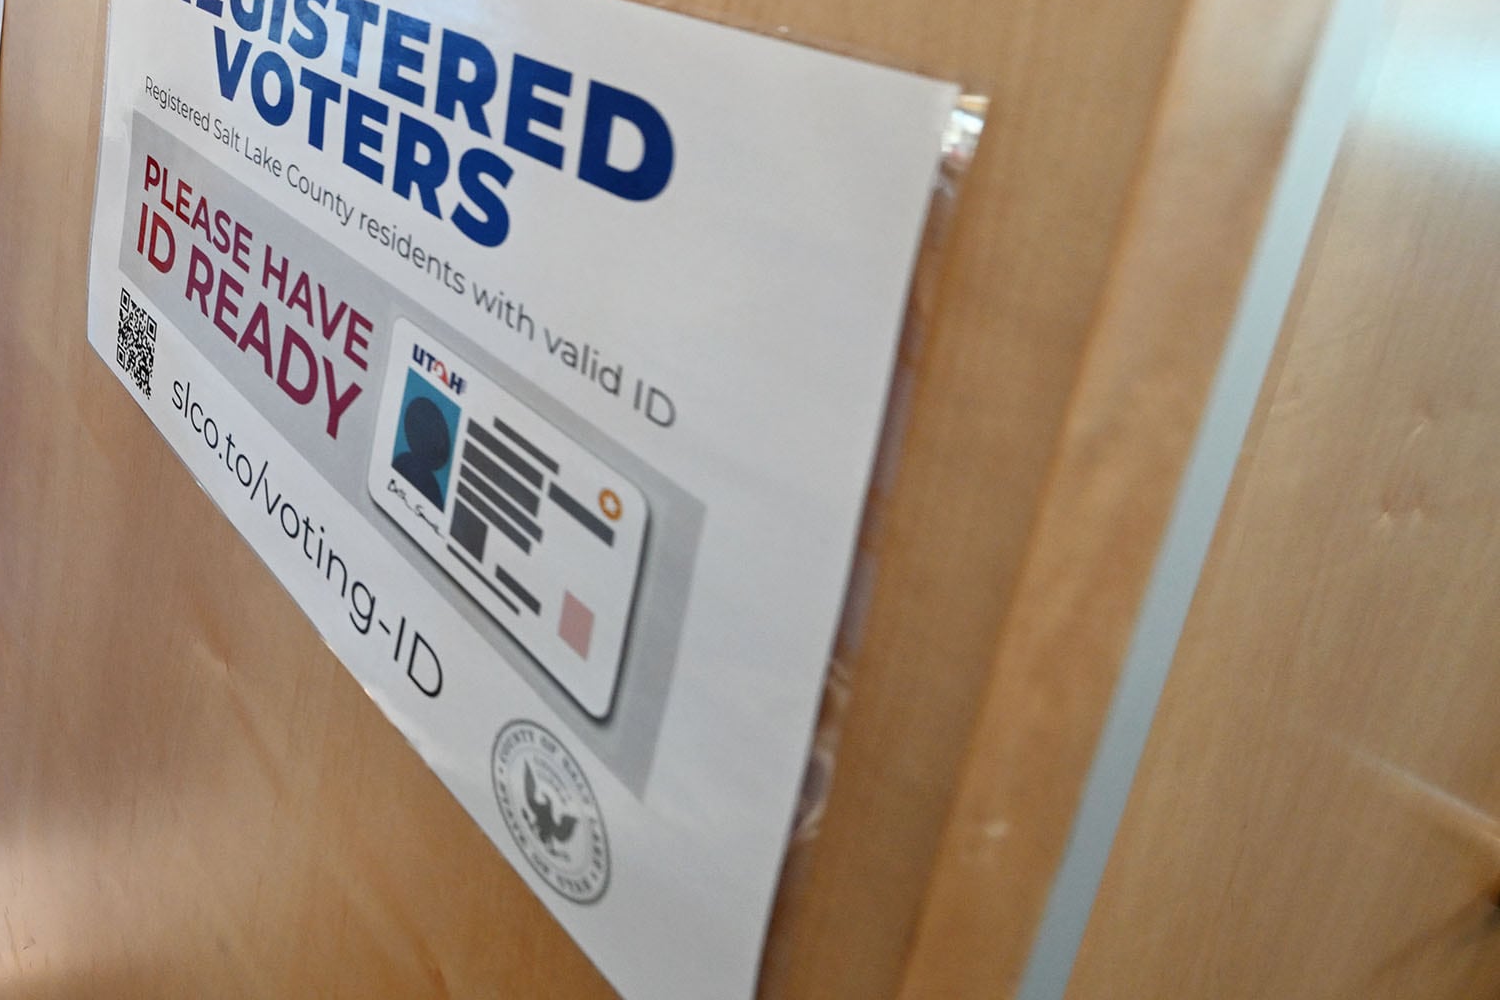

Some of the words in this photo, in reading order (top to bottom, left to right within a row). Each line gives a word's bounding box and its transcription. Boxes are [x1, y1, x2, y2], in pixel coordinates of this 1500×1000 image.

[145, 75, 211, 132] Registered
[213, 118, 241, 153] Salt
[244, 136, 283, 178] Lake
[286, 163, 355, 226] County
[358, 210, 466, 295] residents
[472, 281, 535, 341] with
[543, 327, 623, 397] valid
[633, 378, 677, 429] ID
[213, 26, 515, 248] VOTERS
[137, 202, 176, 276] ID
[185, 244, 364, 441] READY
[143, 154, 253, 270] PLEASE
[262, 241, 374, 373] HAVE
[172, 378, 444, 699] slco.to/voting-ID
